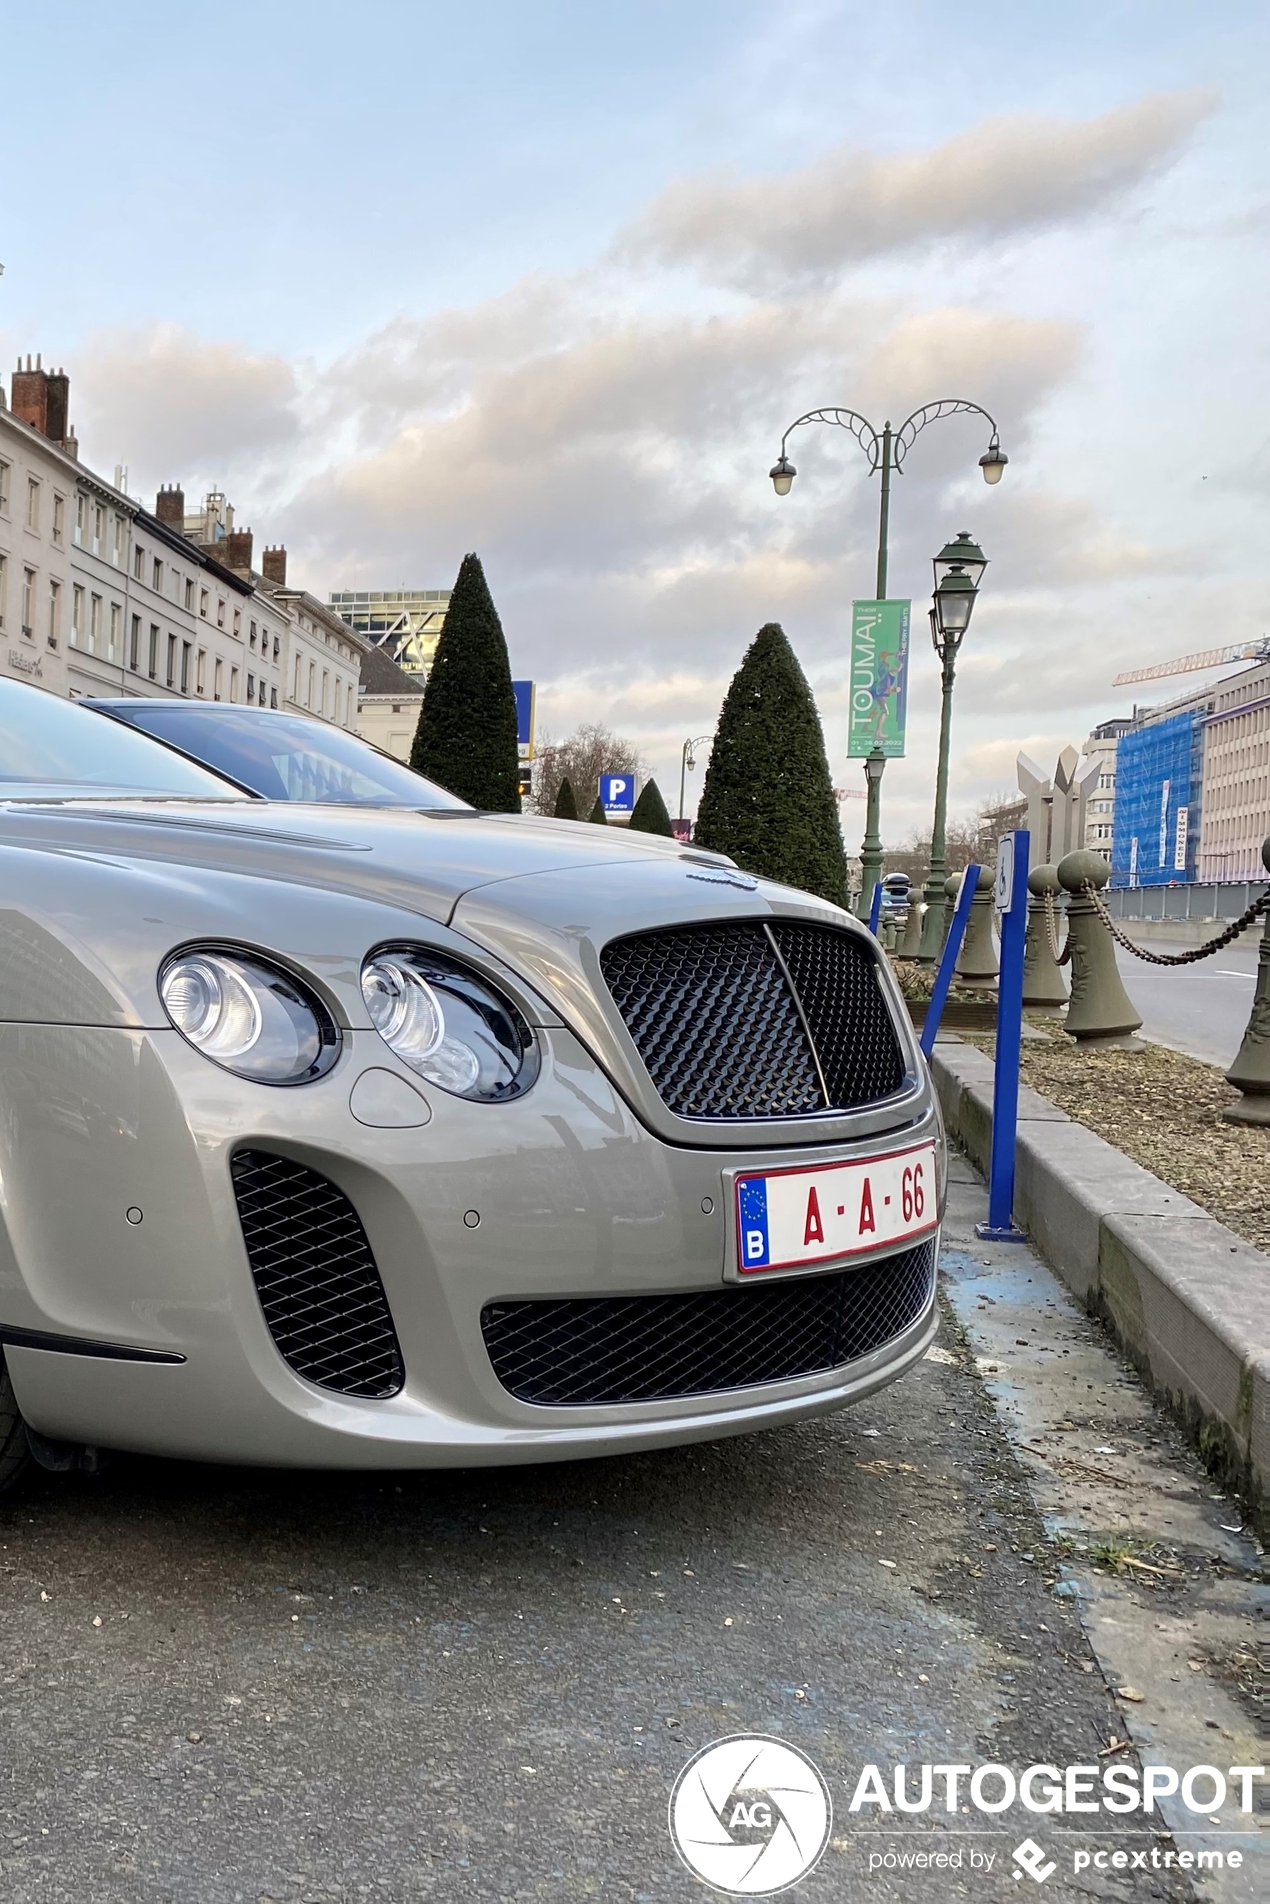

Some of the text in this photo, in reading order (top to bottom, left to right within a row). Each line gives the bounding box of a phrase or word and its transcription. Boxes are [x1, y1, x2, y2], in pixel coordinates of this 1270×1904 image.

[610, 779, 626, 801] P
[747, 1163, 924, 1259] B A-A-66
